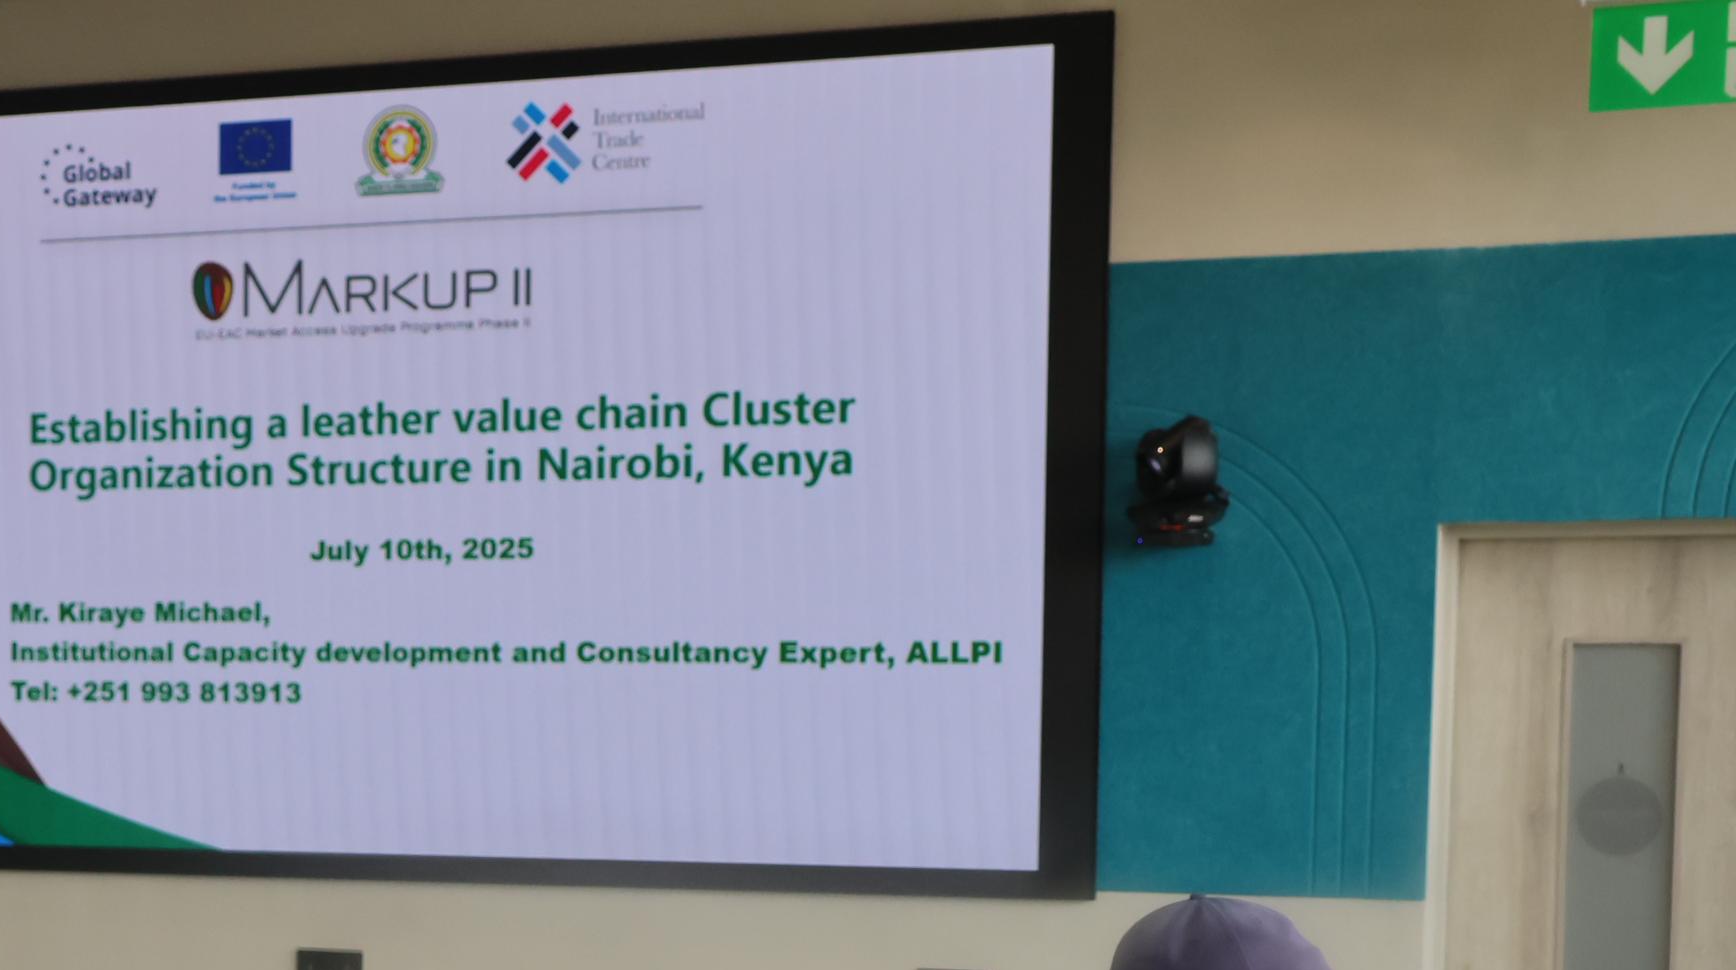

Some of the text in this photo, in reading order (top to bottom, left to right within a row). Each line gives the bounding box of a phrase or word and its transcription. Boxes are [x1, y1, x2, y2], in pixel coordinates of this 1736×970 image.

[593, 101, 705, 125] International
[594, 129, 643, 149] Trade
[64, 162, 130, 183] Global
[592, 155, 651, 171] Centre
[64, 187, 157, 208] Gateway
[514, 268, 531, 307] II
[31, 391, 855, 449] Establishing a leather value chain Cluster
[30, 443, 852, 500] Organization Structure in Nairobi, Kenya
[311, 538, 533, 566] July 10th, 2025
[11, 602, 269, 628] Mr. Kiraye Michael,
[12, 642, 1001, 669] Institutional Capacity development and Consultancy Expert, ALLPI
[11, 681, 300, 703] Tel: +251 993 813913
